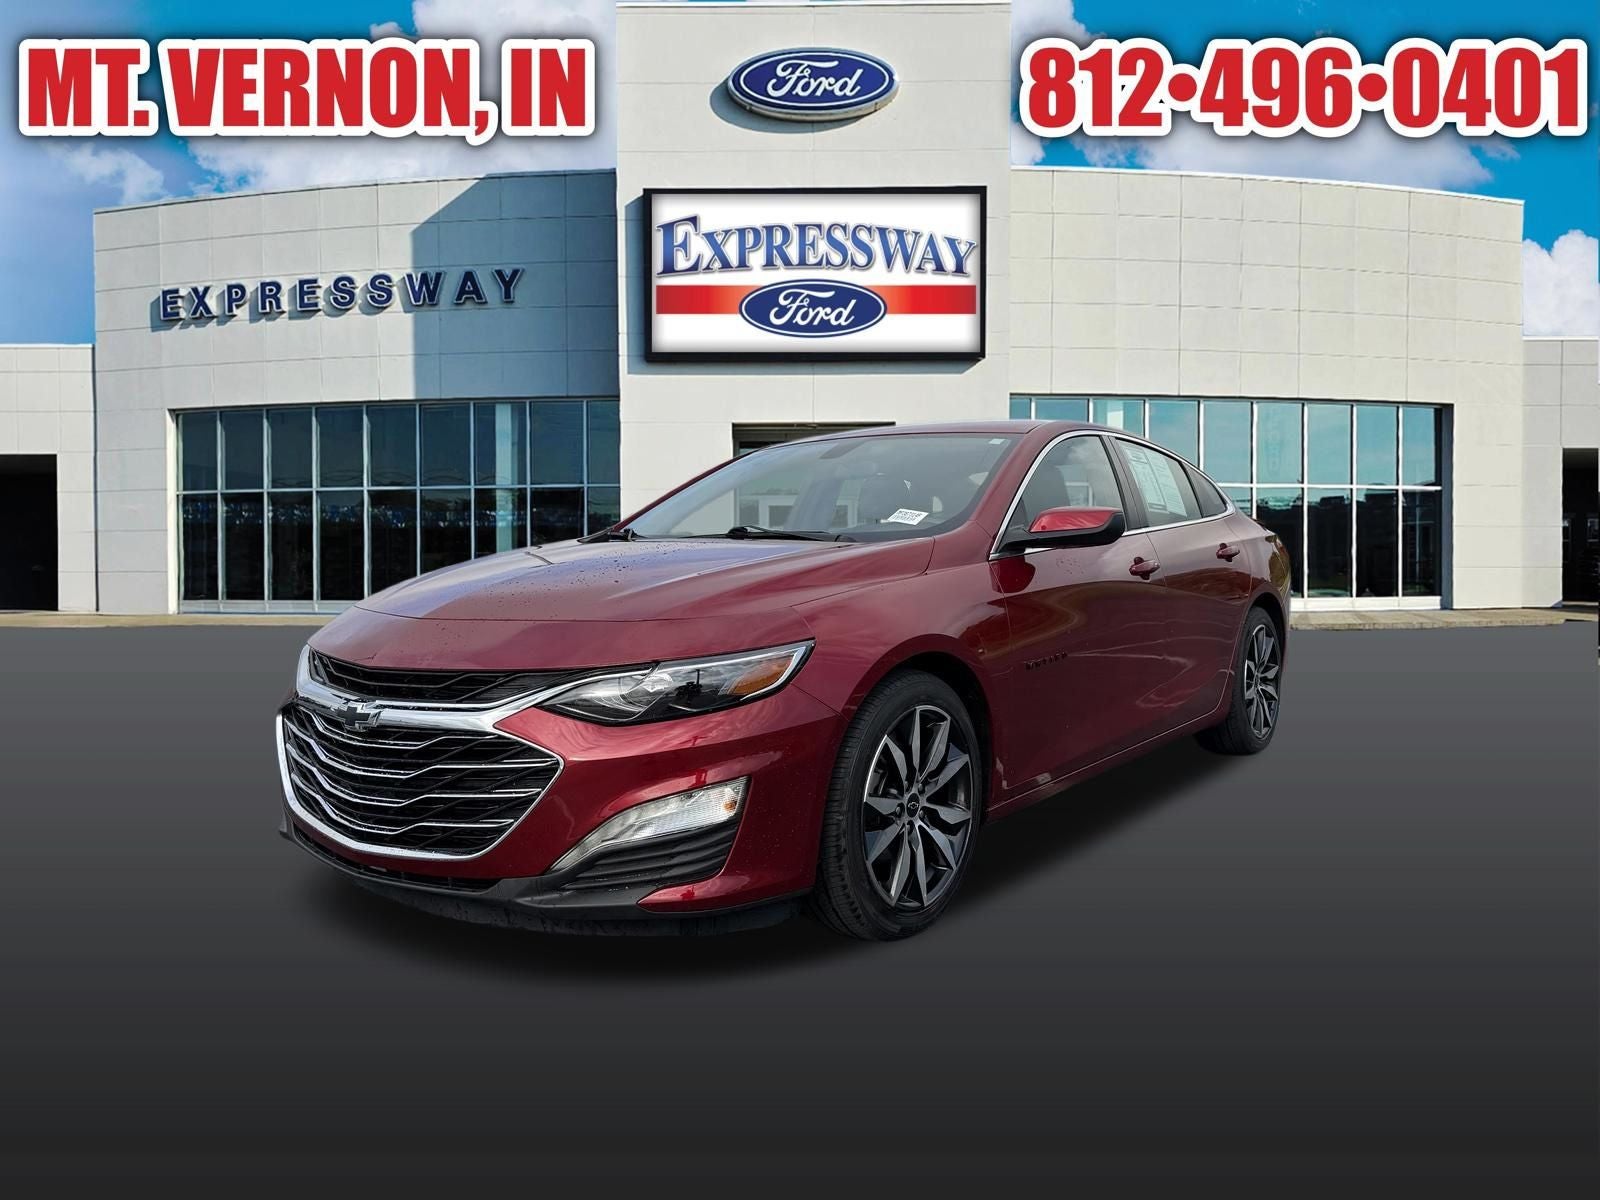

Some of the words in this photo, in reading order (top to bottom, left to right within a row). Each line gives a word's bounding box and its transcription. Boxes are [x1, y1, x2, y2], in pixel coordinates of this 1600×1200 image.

[766, 60, 863, 97] Ford
[656, 214, 977, 277] EXPRESSWAY
[160, 268, 525, 321] EXPRESSWAY
[769, 288, 858, 327] Ford
